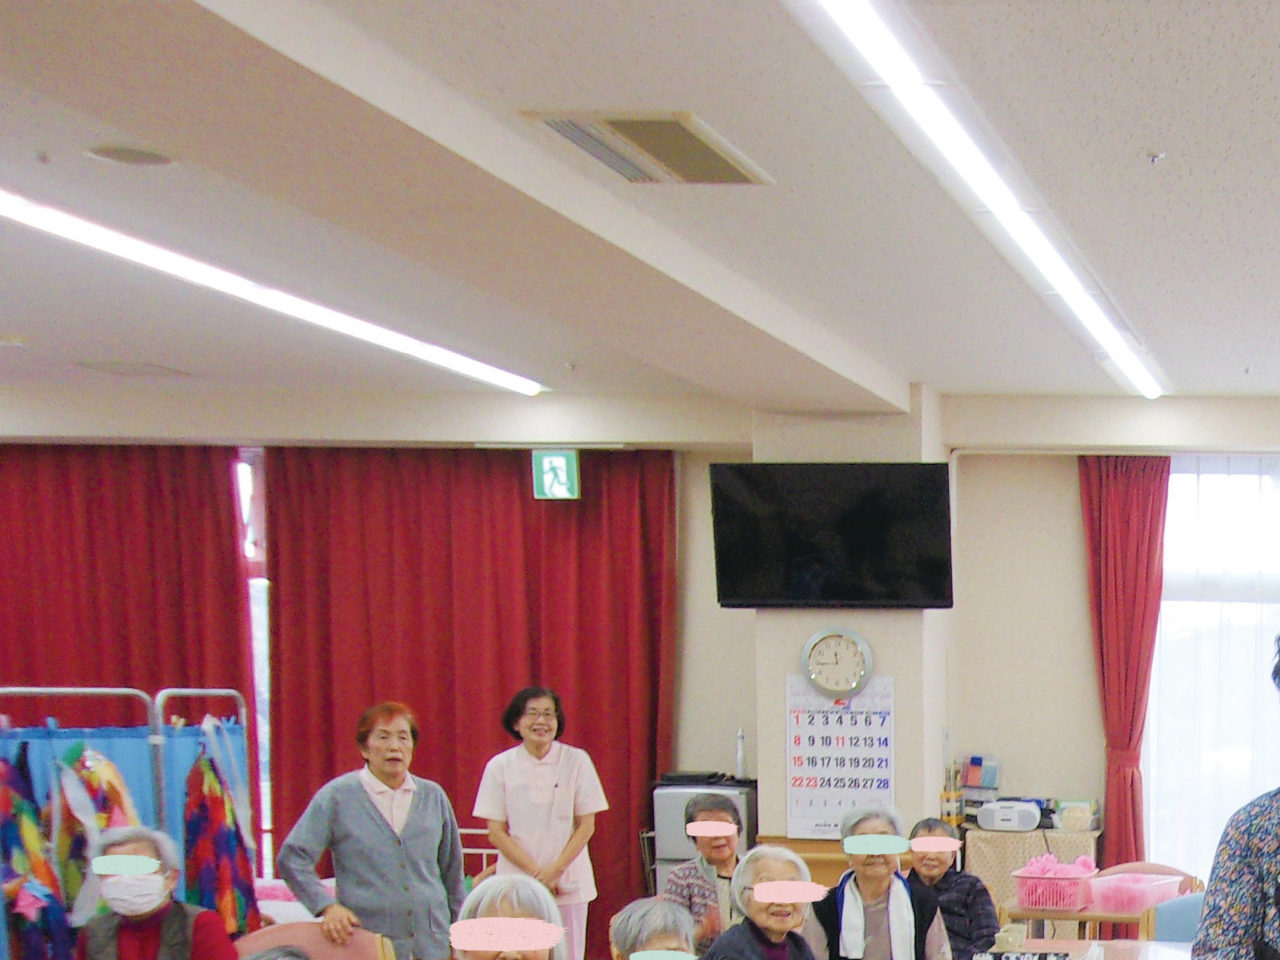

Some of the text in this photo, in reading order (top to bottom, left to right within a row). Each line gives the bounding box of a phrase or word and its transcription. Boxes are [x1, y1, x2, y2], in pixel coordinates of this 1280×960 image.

[794, 714, 886, 727] 1 2 3 4 5 6 7
[794, 735, 888, 748] 8 9 10 11 12 13 14
[793, 756, 888, 769] 15 16 17 18 19 20 21
[792, 776, 889, 790] 22 23 24 25 26 27 28
